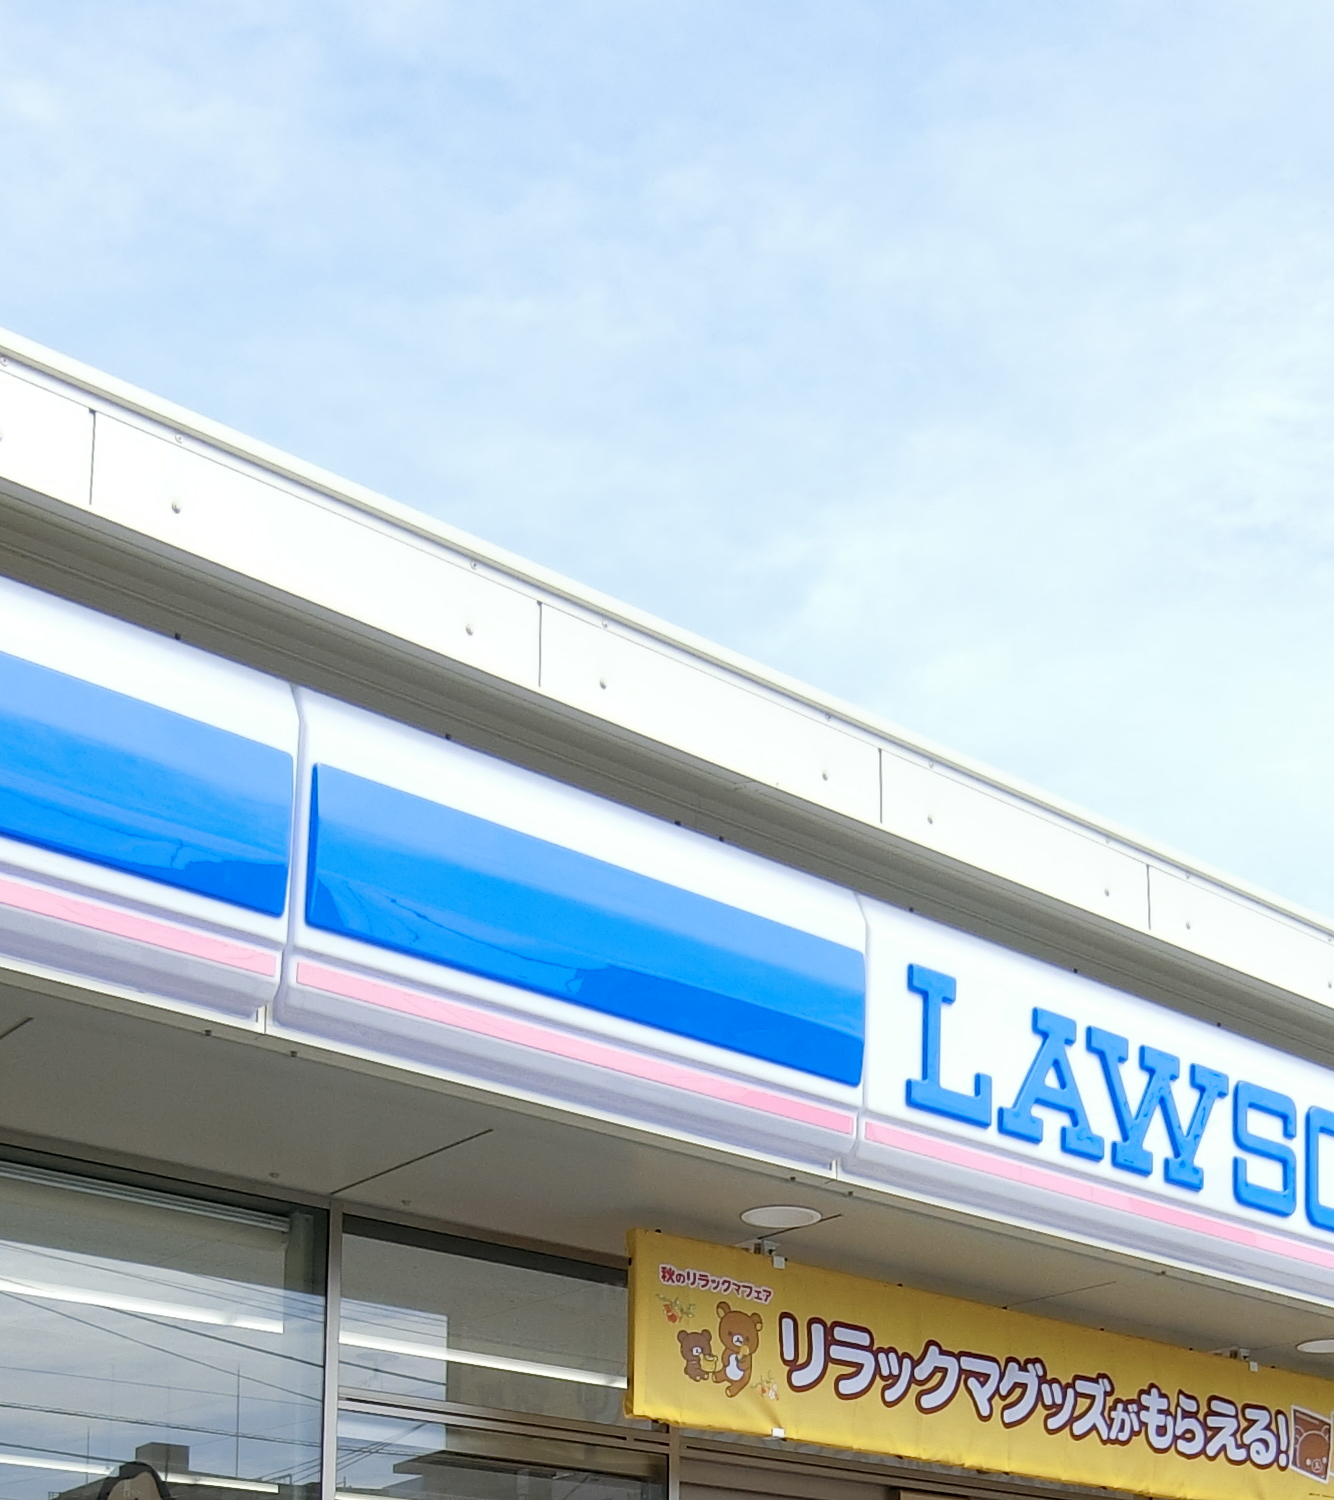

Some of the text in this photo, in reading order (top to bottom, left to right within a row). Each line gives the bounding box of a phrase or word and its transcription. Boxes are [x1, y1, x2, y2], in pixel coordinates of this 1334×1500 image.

[658, 1264, 773, 1304] 秋のリラックマフェア
[779, 1310, 1291, 1470] リラックマグッズがもらえる!
